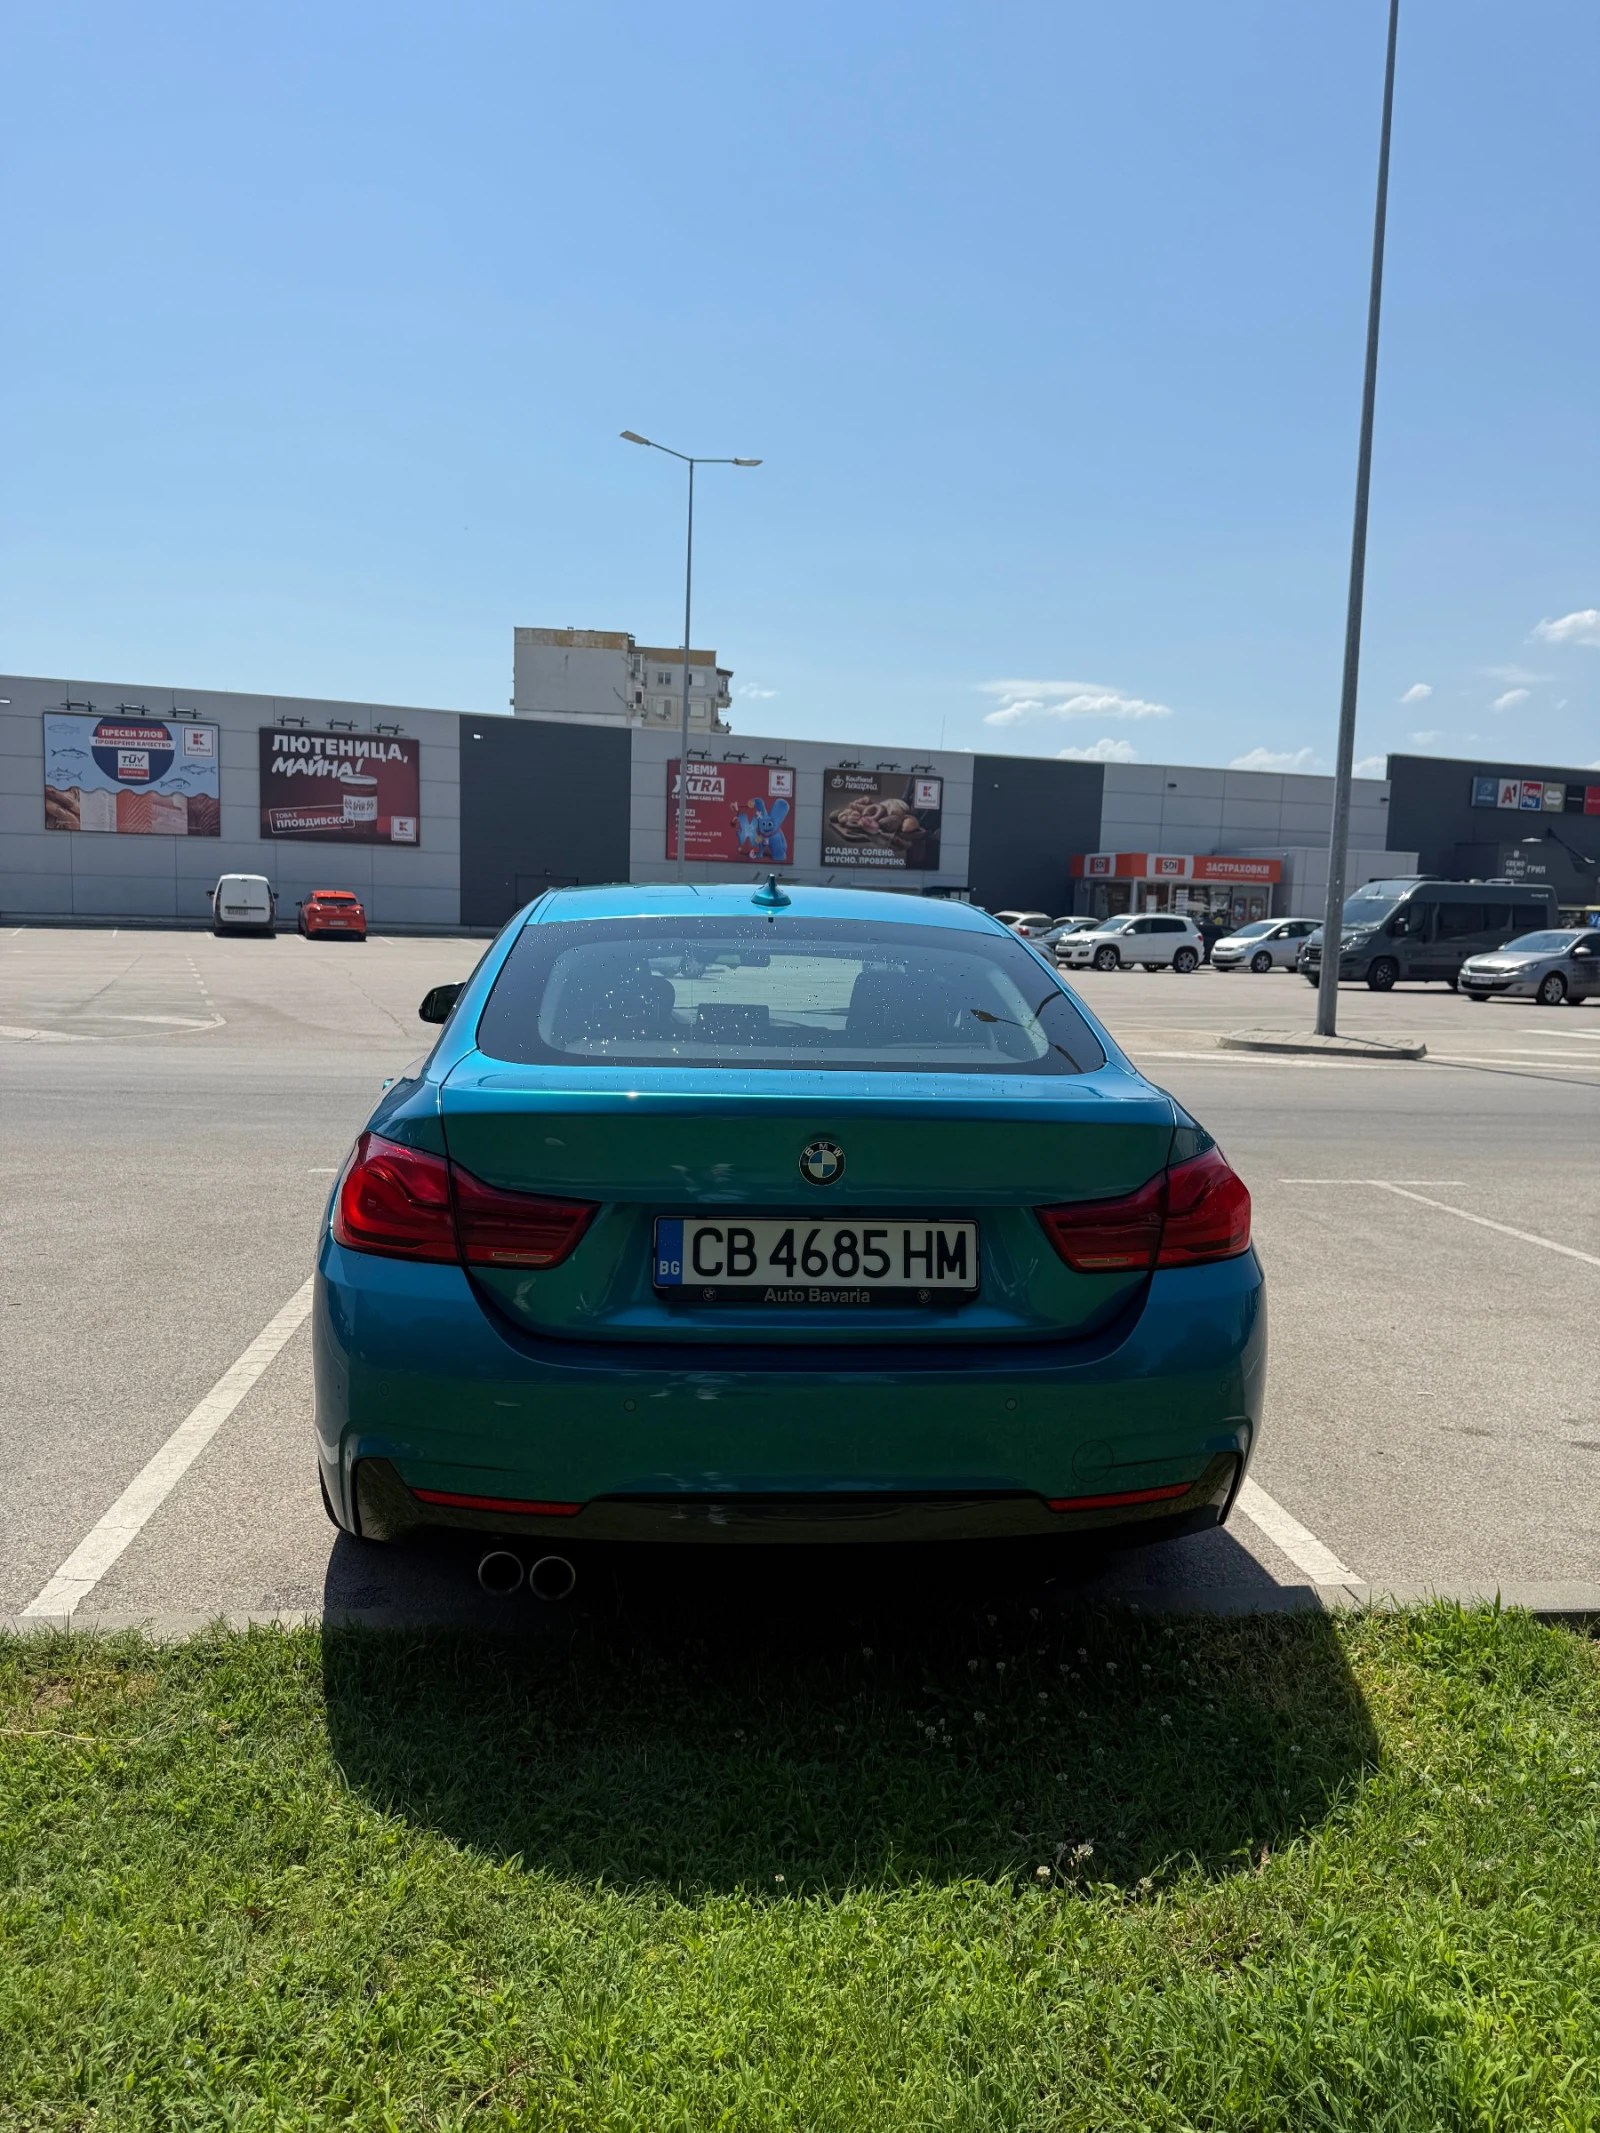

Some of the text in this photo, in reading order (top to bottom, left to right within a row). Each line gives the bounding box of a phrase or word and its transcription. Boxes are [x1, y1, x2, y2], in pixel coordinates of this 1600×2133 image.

[101, 728, 163, 739] ПРЕСЕН УЛОВ
[272, 734, 409, 764] ЛЮТЕНИЦА,
[121, 754, 145, 763] TÜV
[271, 754, 364, 779] МАЙНА!
[680, 764, 718, 776] ЗЕМИ
[845, 775, 873, 784] Kaufland
[1502, 783, 1519, 804] A1
[1523, 785, 1541, 797] Easy
[1522, 796, 1538, 807] Pay
[276, 816, 350, 829] ПЛОВДИВСКО!
[825, 846, 895, 857] СЛАДКО. СОЛЕНО.
[824, 856, 906, 866] ВКУСНО. ПРОВЕРЕНО.
[1095, 860, 1104, 869] SDI
[1163, 861, 1178, 870] SDI
[1205, 861, 1270, 875] ЗАСТРАХОВКИ
[1527, 865, 1546, 874] ГРИЛ
[804, 1143, 843, 1157] BMW
[692, 1227, 967, 1280] CB 4685 HM
[659, 1260, 680, 1275] BG
[763, 1287, 871, 1303] Auto Bavaria
